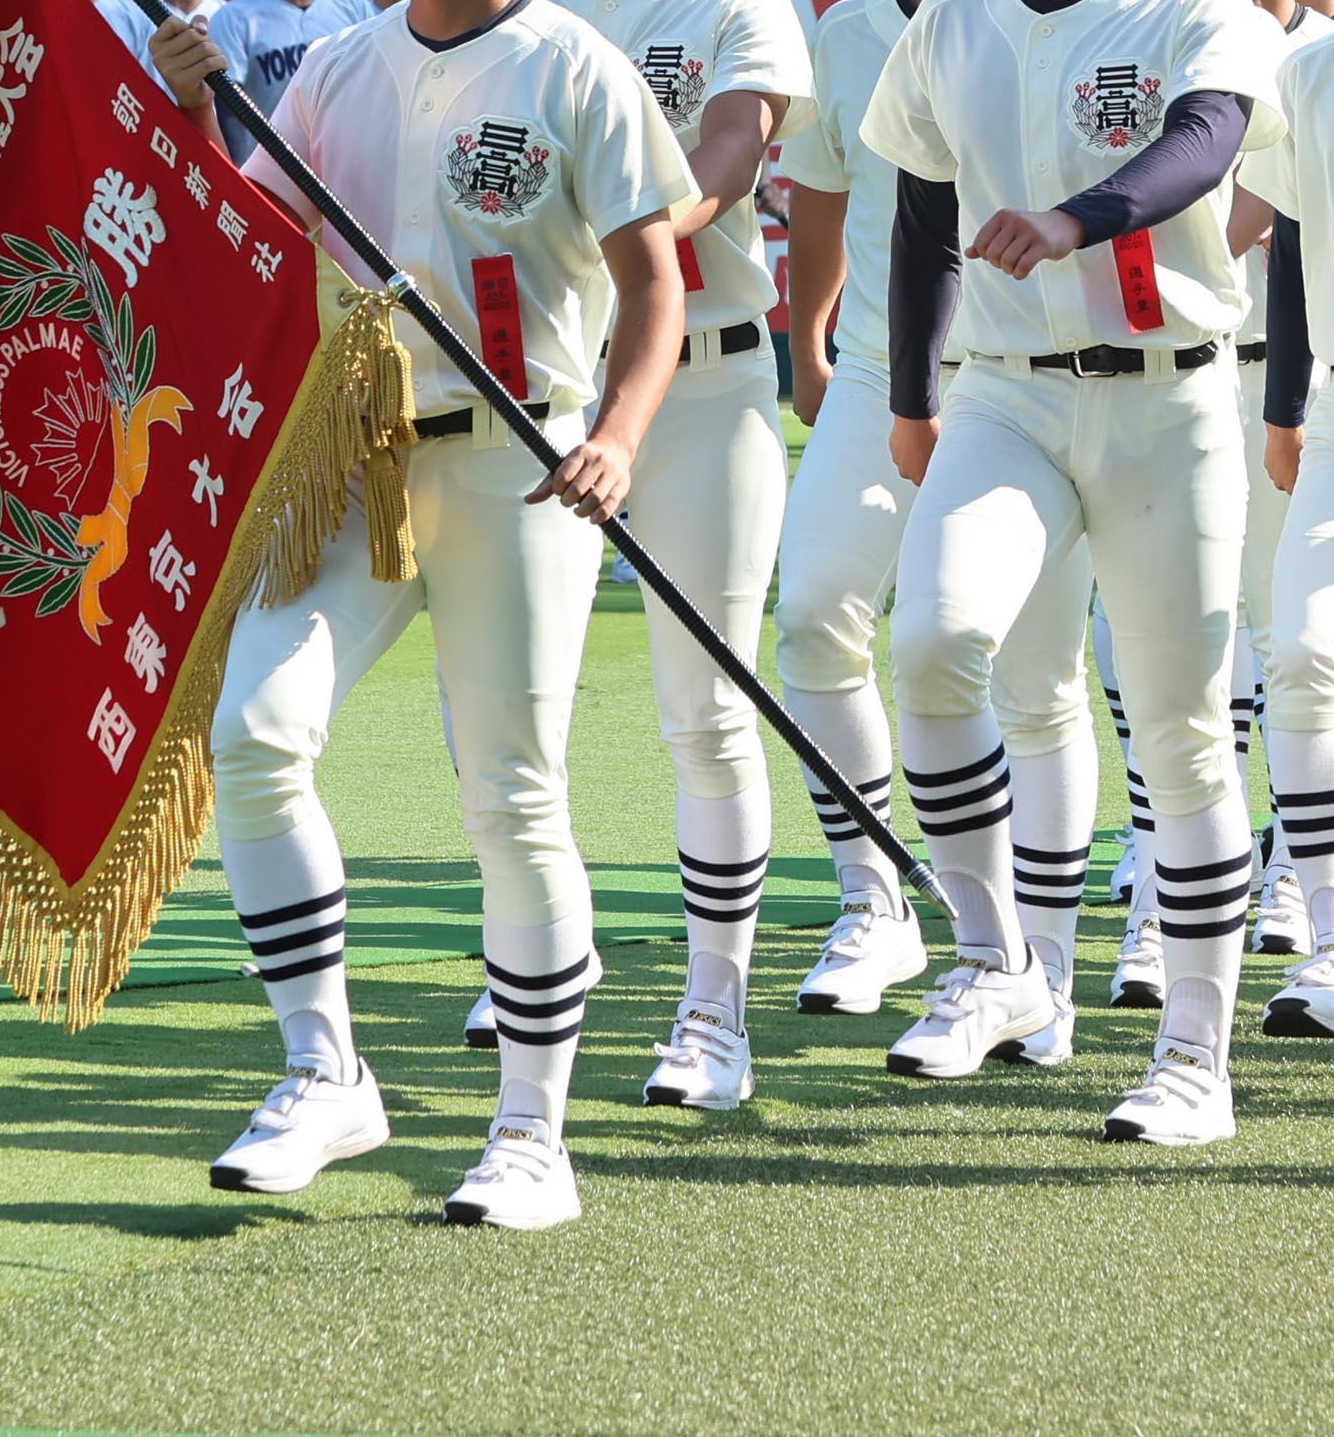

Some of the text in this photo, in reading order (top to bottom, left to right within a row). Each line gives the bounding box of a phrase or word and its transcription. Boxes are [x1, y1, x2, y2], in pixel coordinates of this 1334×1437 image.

[111, 82, 283, 283] 朝日新聞社
[0, 322, 84, 367] PALMAE
[86, 362, 266, 776] 西東京大会
